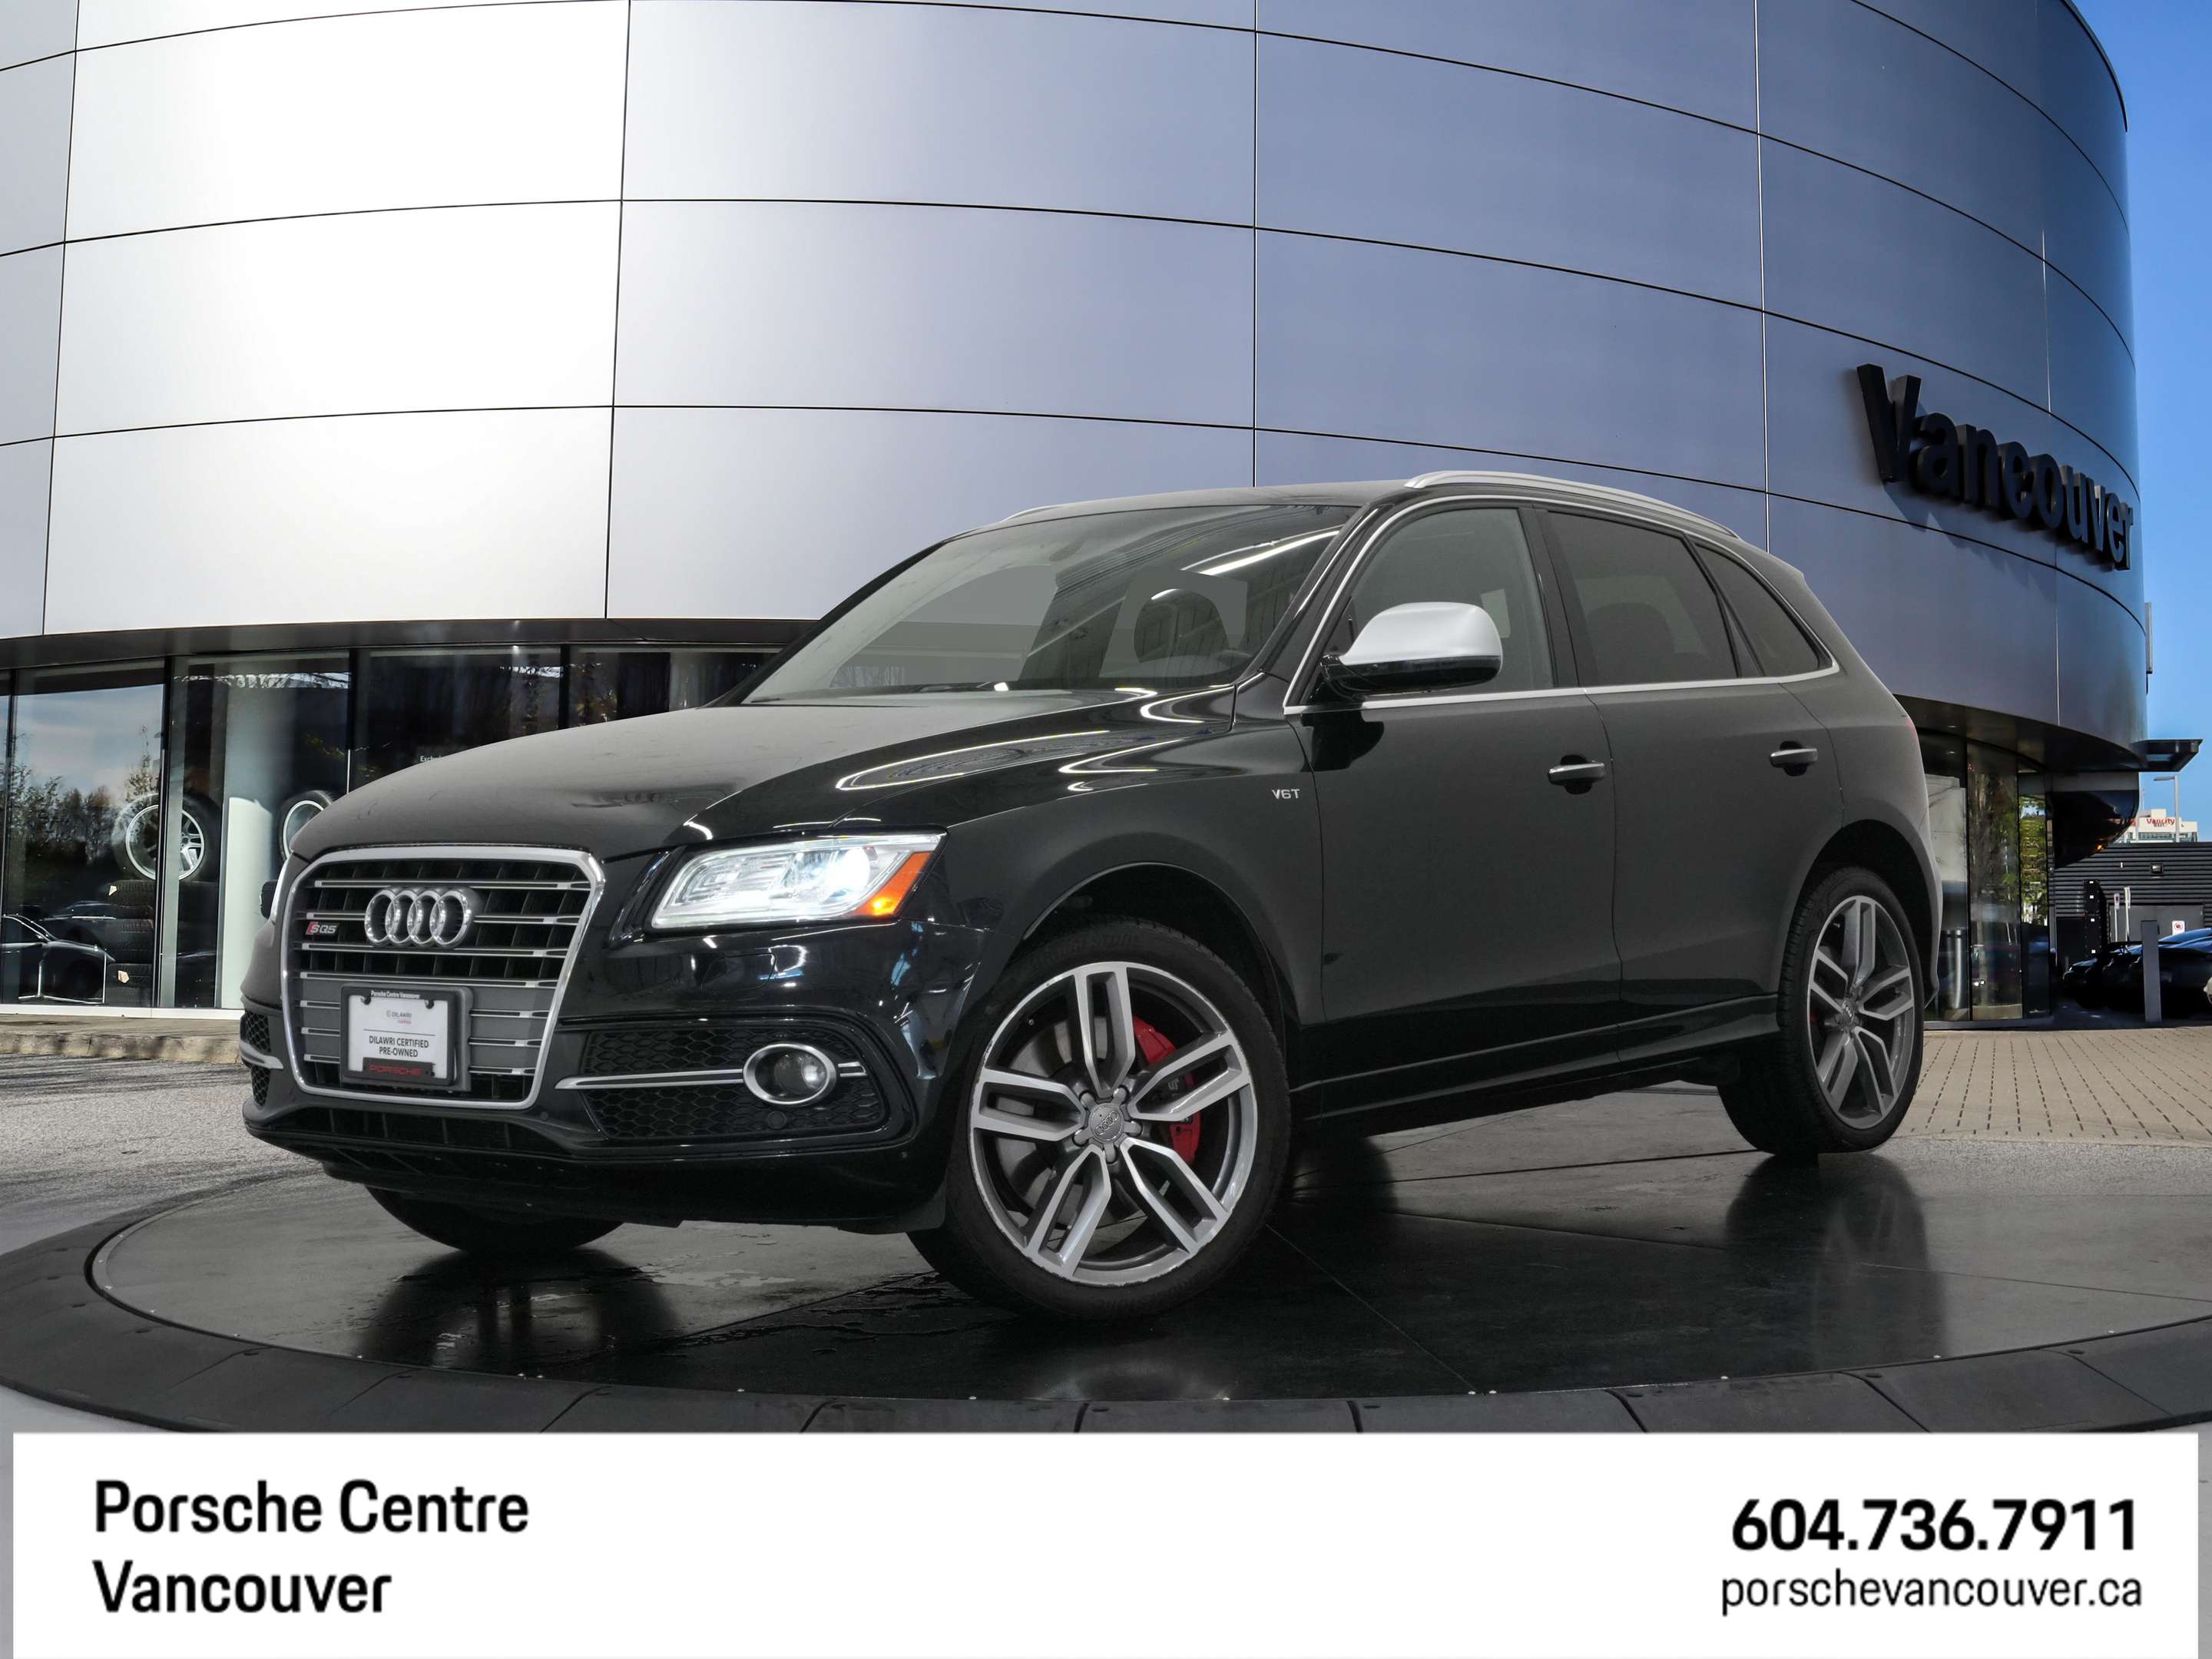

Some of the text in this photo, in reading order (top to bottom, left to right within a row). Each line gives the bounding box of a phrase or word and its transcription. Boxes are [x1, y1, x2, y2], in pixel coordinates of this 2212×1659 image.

[1856, 363, 2134, 571] Vancouver
[1271, 788, 1300, 799] V6T
[309, 923, 337, 934] SQ5
[369, 1035, 429, 1048] DILAWRI CERTIFIED
[379, 1046, 419, 1058] PRE-OWNED
[369, 1064, 422, 1075] PORSCHE
